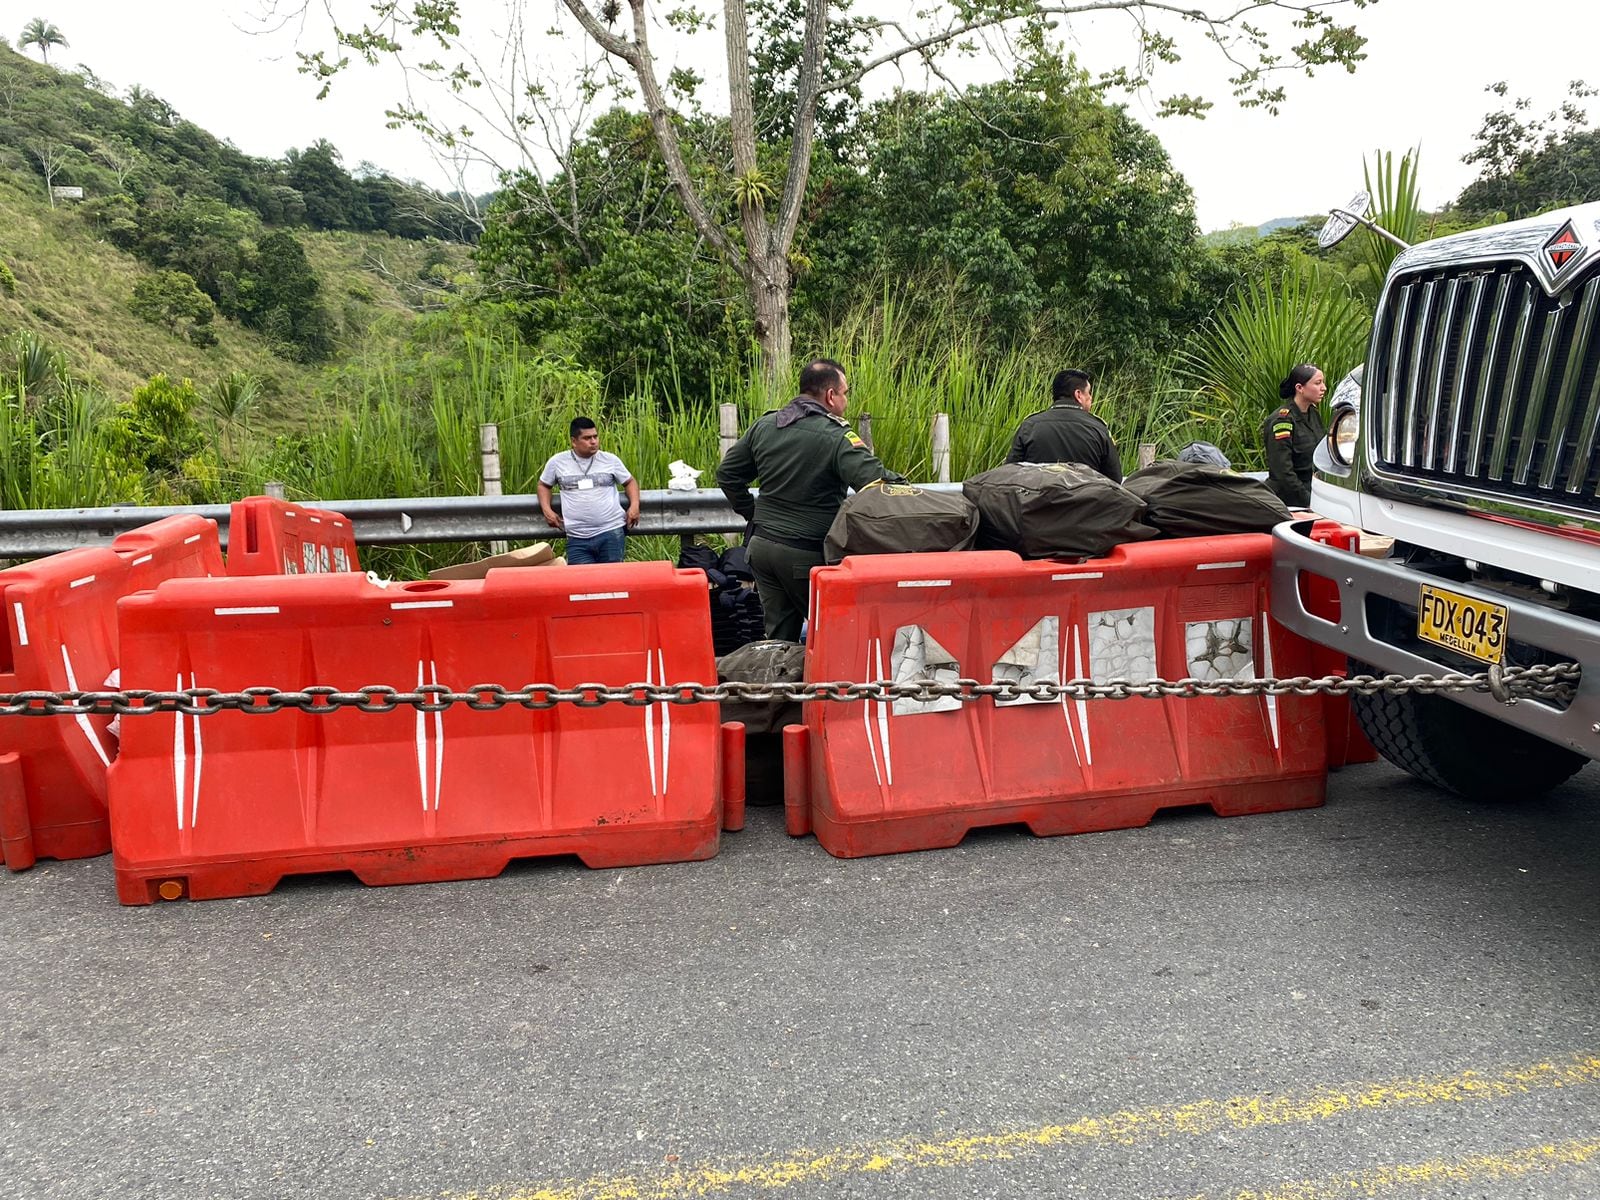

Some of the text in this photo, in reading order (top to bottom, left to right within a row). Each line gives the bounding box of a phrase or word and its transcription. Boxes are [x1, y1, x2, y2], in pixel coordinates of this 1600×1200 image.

[1421, 593, 1503, 647] FDX 043
[1440, 632, 1477, 654] MEDELLIN
